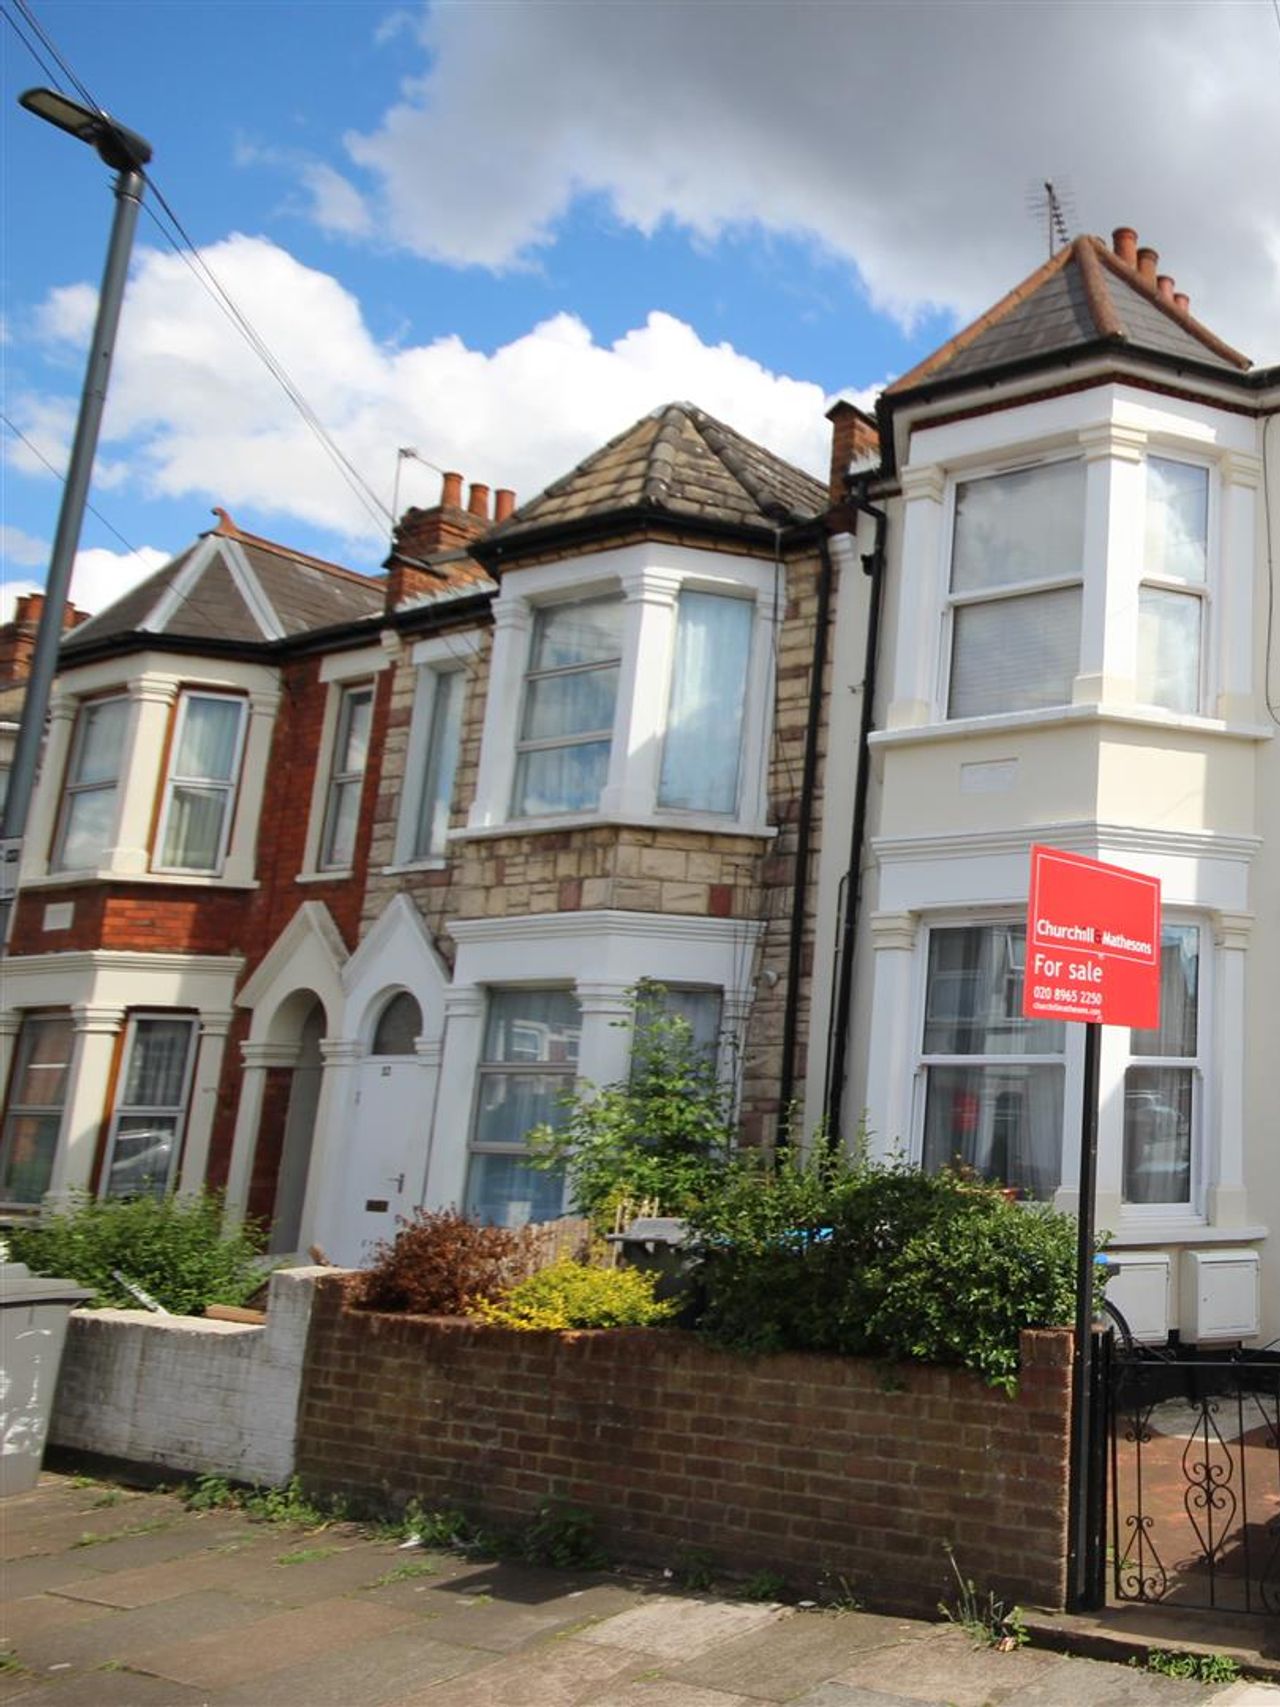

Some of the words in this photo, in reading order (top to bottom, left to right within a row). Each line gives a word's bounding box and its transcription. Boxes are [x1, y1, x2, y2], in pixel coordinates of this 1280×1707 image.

[1037, 919, 1095, 943] Churchill
[1102, 931, 1152, 954] Mathesons
[1034, 953, 1063, 977] For
[1069, 960, 1103, 983] sale
[1033, 985, 1052, 1000] 020
[1054, 988, 1078, 1003] 8965
